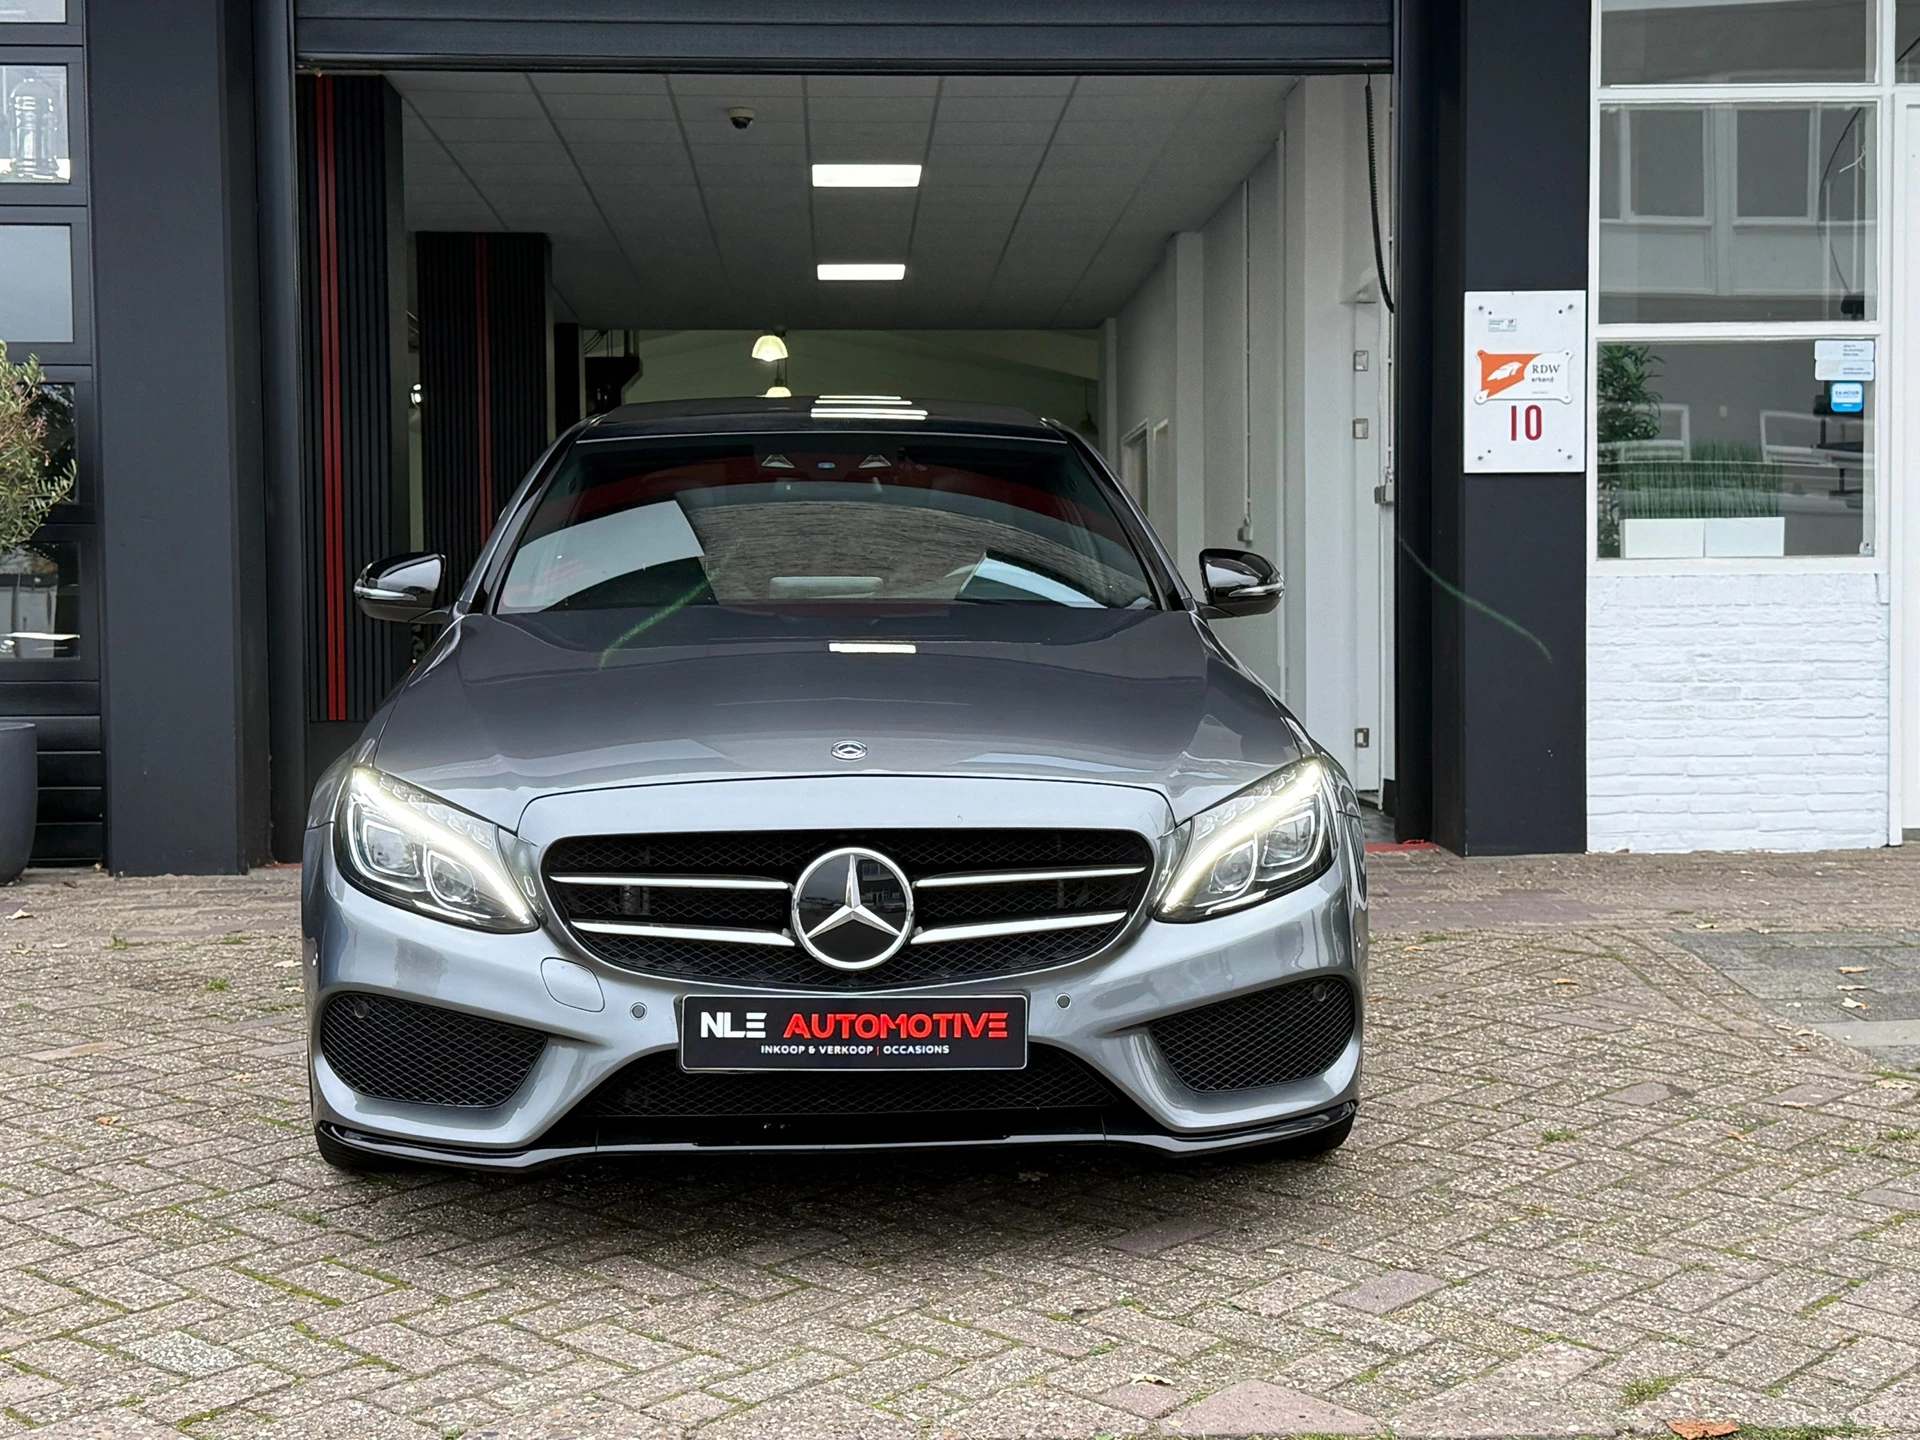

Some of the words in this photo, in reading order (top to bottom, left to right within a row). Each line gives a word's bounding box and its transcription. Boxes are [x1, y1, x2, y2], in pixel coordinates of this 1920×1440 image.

[1532, 364, 1560, 374] RDW
[1511, 404, 1542, 441] 10
[700, 1012, 767, 1038] NLE
[783, 1012, 1008, 1039] AUTOMOTIVE
[760, 1045, 805, 1055] INKOOP
[808, 1045, 816, 1055] &
[819, 1045, 874, 1055] VERKOOP
[883, 1045, 949, 1055] OCCASIONS
